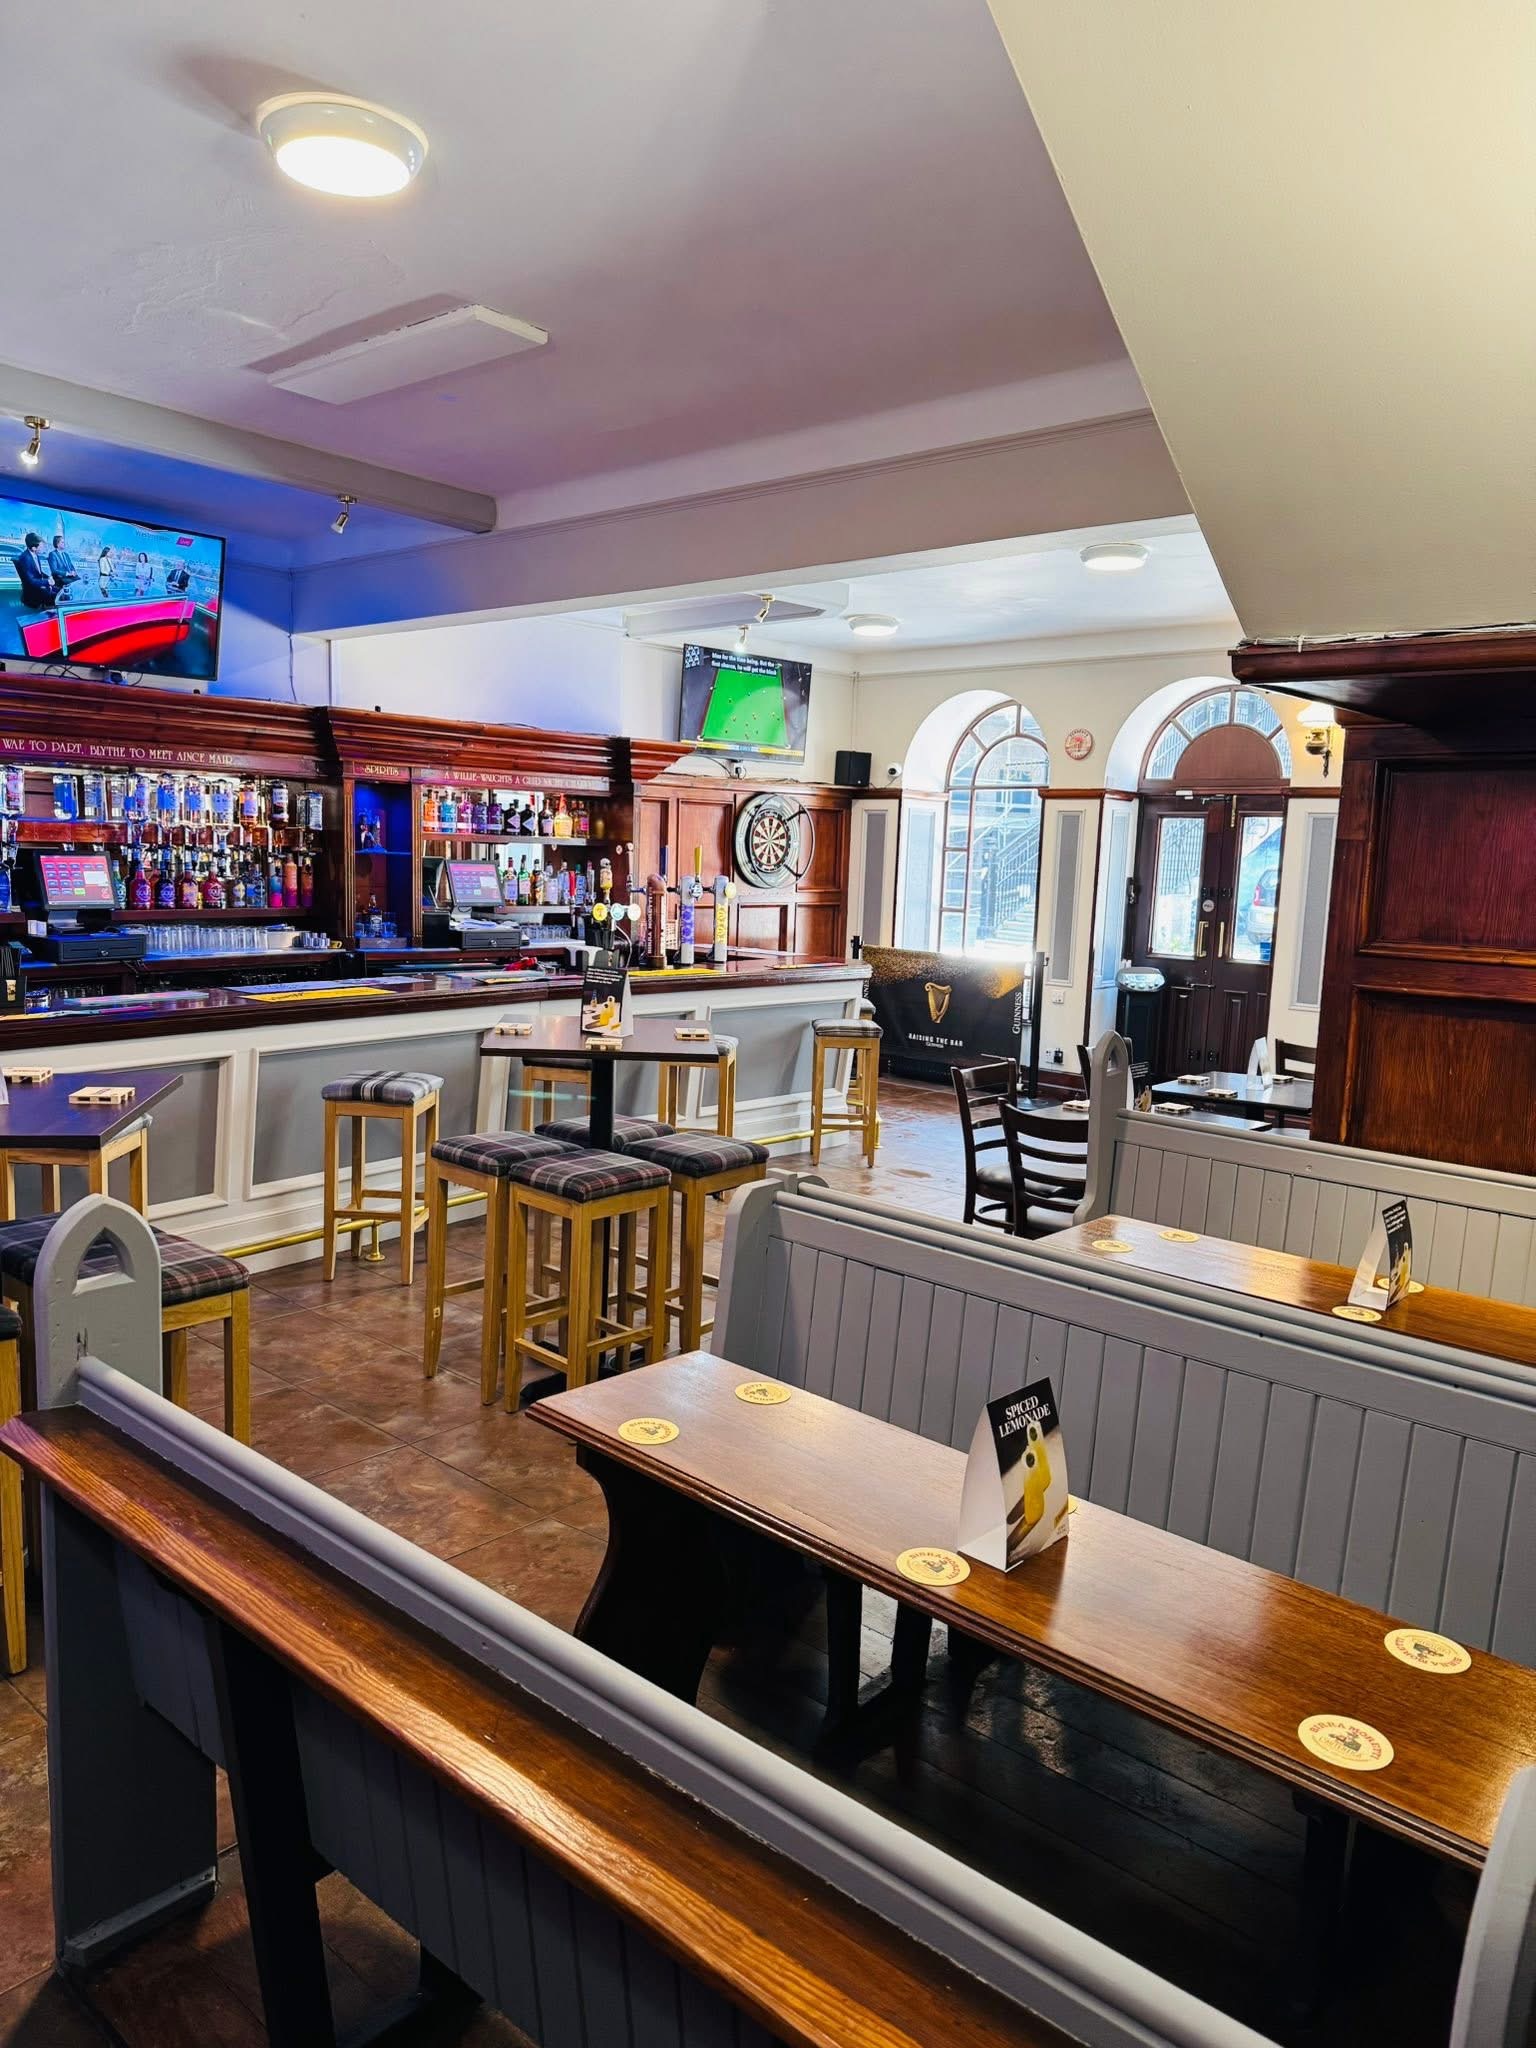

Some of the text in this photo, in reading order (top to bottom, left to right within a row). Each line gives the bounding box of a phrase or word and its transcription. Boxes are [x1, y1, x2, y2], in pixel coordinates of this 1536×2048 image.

[2, 738, 25, 750] WAE
[29, 740, 47, 751] TO
[90, 745, 126, 757] BLYTHE
[129, 748, 146, 758] TO
[149, 749, 174, 760] MEET
[176, 751, 205, 763] AINCE
[364, 764, 399, 776] SPIRITS
[515, 776, 520, 784] A
[1011, 991, 1023, 1034] GUINNESS
[936, 1036, 948, 1045] THE
[950, 1039, 963, 1047] BAR
[998, 1403, 1051, 1438] LEMONADE
[1005, 1394, 1039, 1421] SPICED
[1310, 1721, 1382, 1760] BIRRA MORETTI
